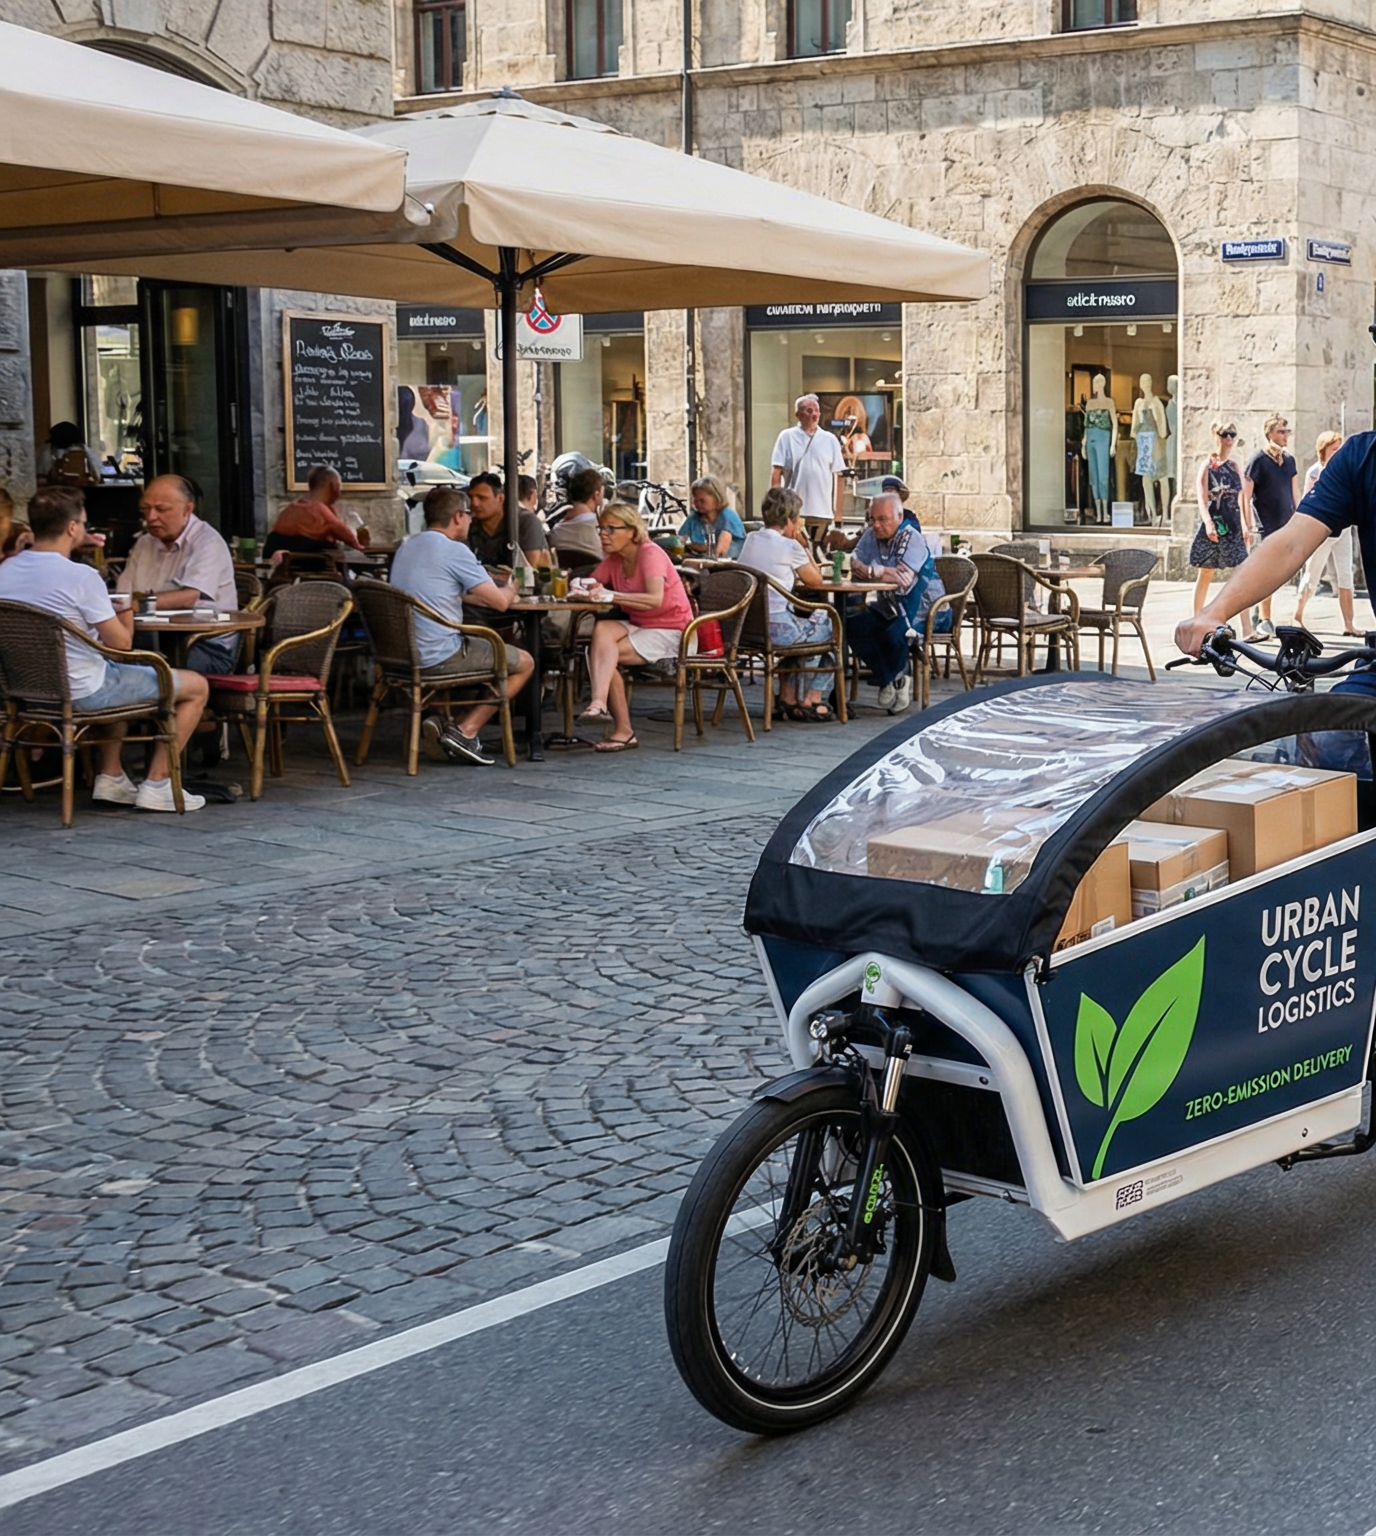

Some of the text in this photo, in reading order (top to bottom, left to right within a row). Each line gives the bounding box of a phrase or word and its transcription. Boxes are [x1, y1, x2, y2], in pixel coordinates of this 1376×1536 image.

[1261, 885, 1361, 947] URBAN
[1259, 929, 1358, 996] CYCLE
[1258, 977, 1356, 1034] LOGISTICS
[1185, 1044, 1353, 1121] ZERO-EMISSION DELIVERY
